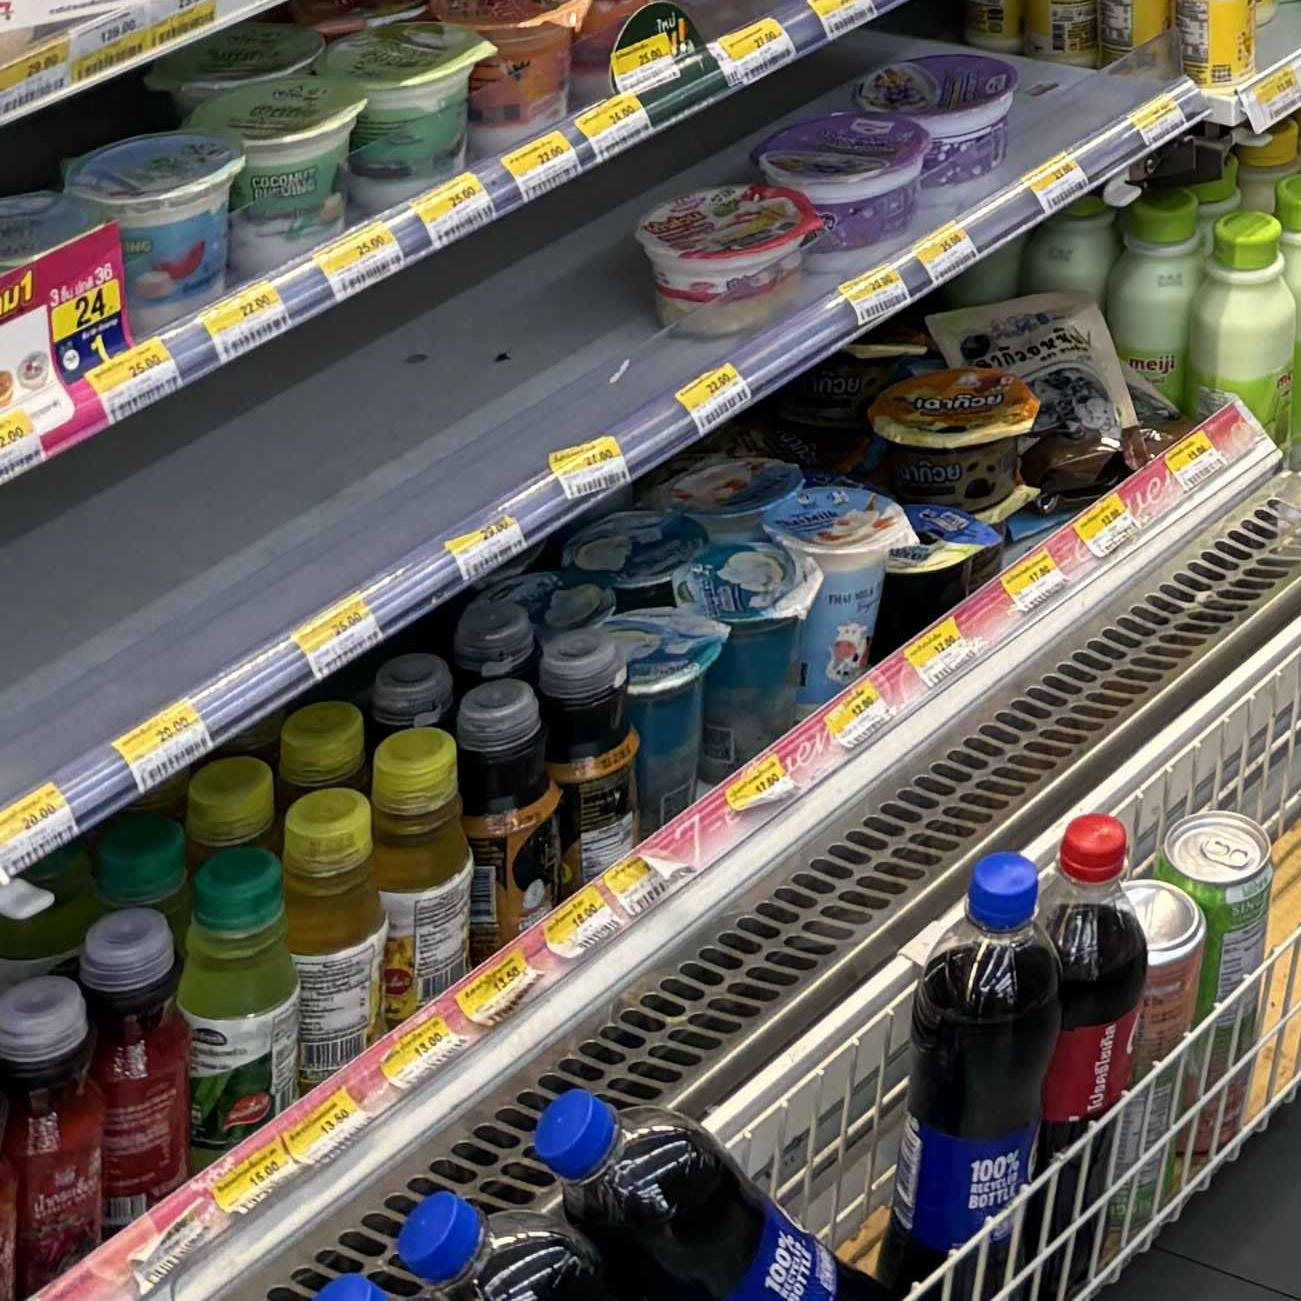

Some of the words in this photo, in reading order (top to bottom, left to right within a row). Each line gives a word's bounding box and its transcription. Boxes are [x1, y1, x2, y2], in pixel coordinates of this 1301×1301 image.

[94, 262, 112, 282] 36
[75, 288, 105, 329] 24
[129, 355, 161, 377] 25.00
[1129, 354, 1176, 373] meiji
[414, 1032, 442, 1056] 13.00
[249, 1160, 280, 1186] 15.00
[970, 1148, 1019, 1181] 100%
[765, 1231, 796, 1296] 100%
